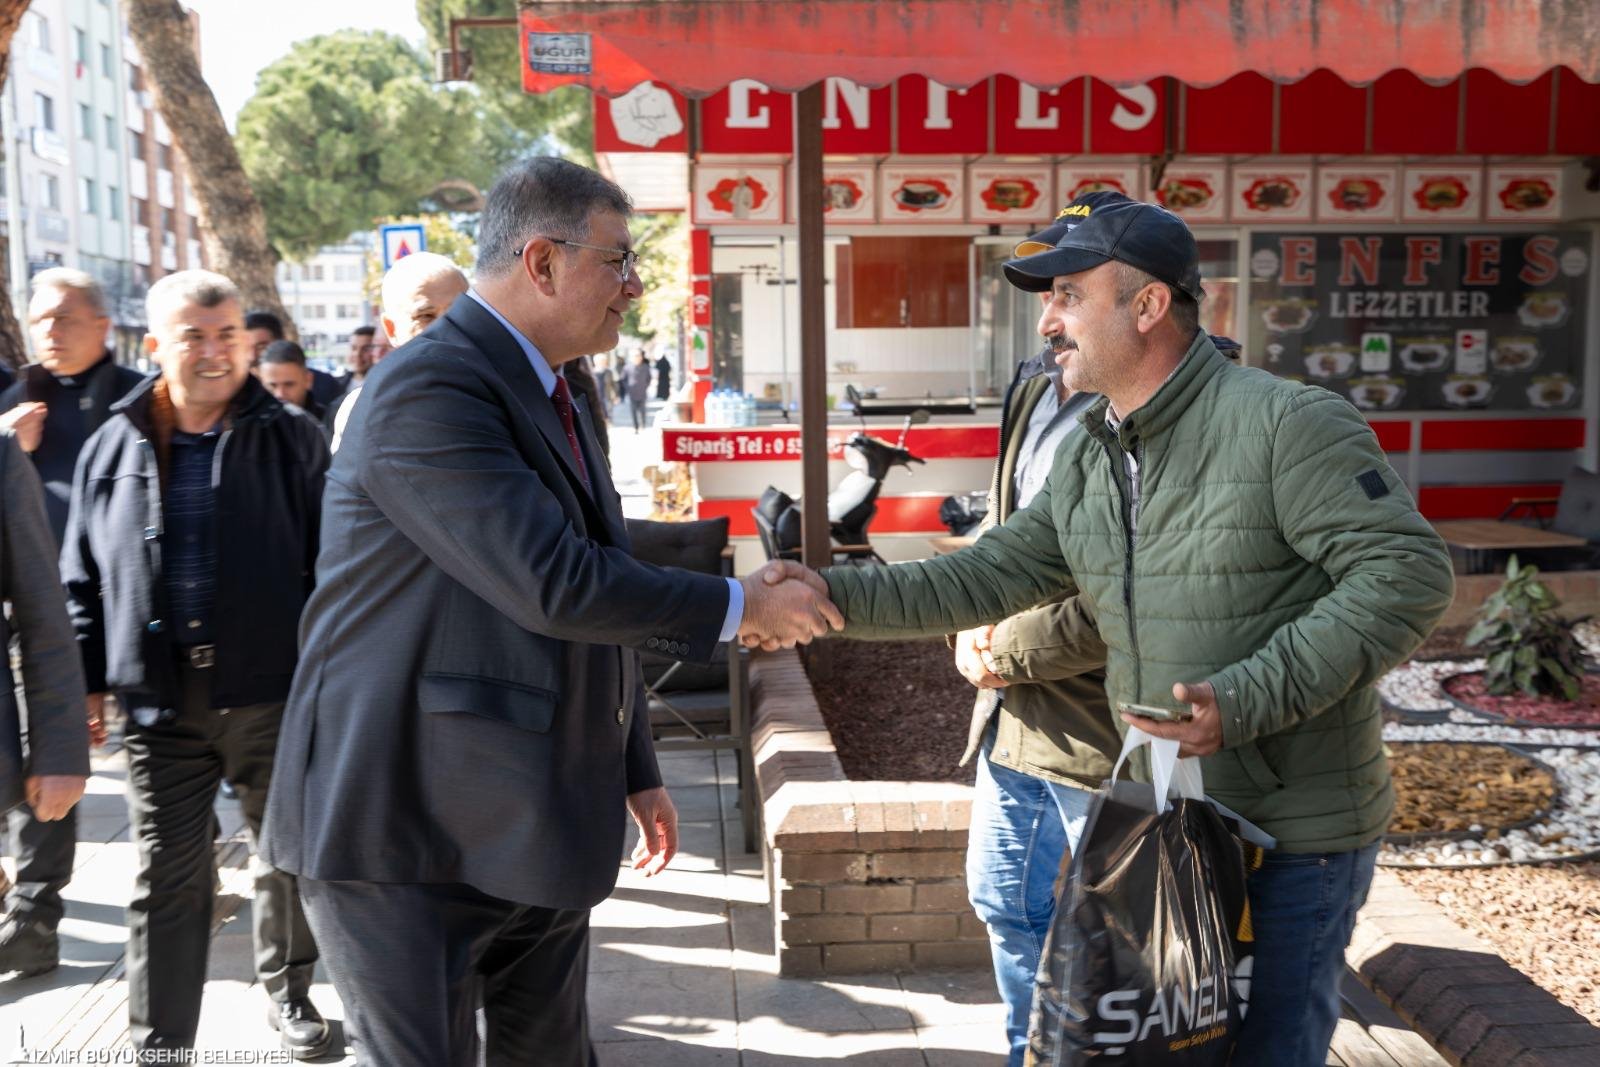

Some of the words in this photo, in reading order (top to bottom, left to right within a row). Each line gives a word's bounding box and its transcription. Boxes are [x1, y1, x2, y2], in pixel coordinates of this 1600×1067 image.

[1278, 235, 1560, 286] ENFES
[1329, 291, 1489, 318] LEZZETLER
[676, 436, 734, 459] Sipariş
[736, 436, 762, 454] Tel
[774, 437, 785, 454] 0
